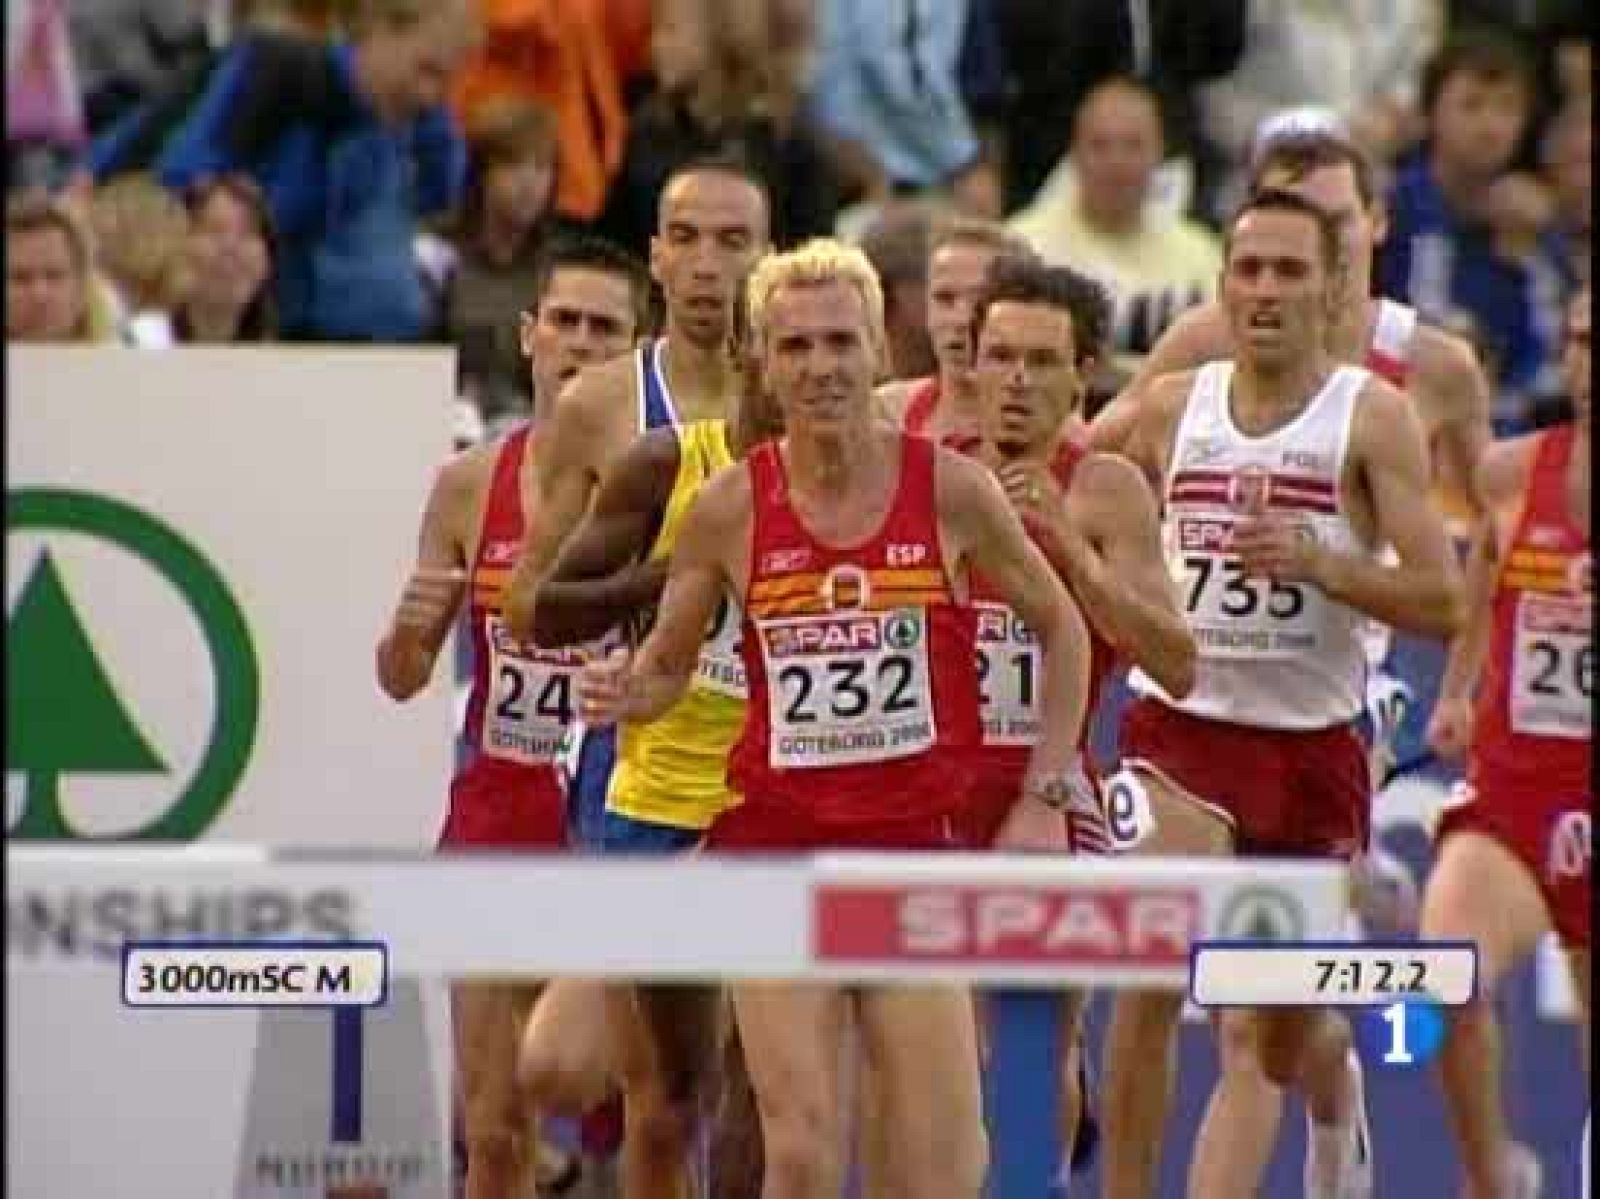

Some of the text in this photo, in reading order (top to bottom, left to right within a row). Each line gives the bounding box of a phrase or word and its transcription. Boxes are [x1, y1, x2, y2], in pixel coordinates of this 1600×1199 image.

[886, 543, 926, 566] ESP
[1184, 558, 1303, 618] 735
[497, 665, 571, 726] 24
[778, 656, 919, 723] 232
[896, 888, 1191, 954] SPAR
